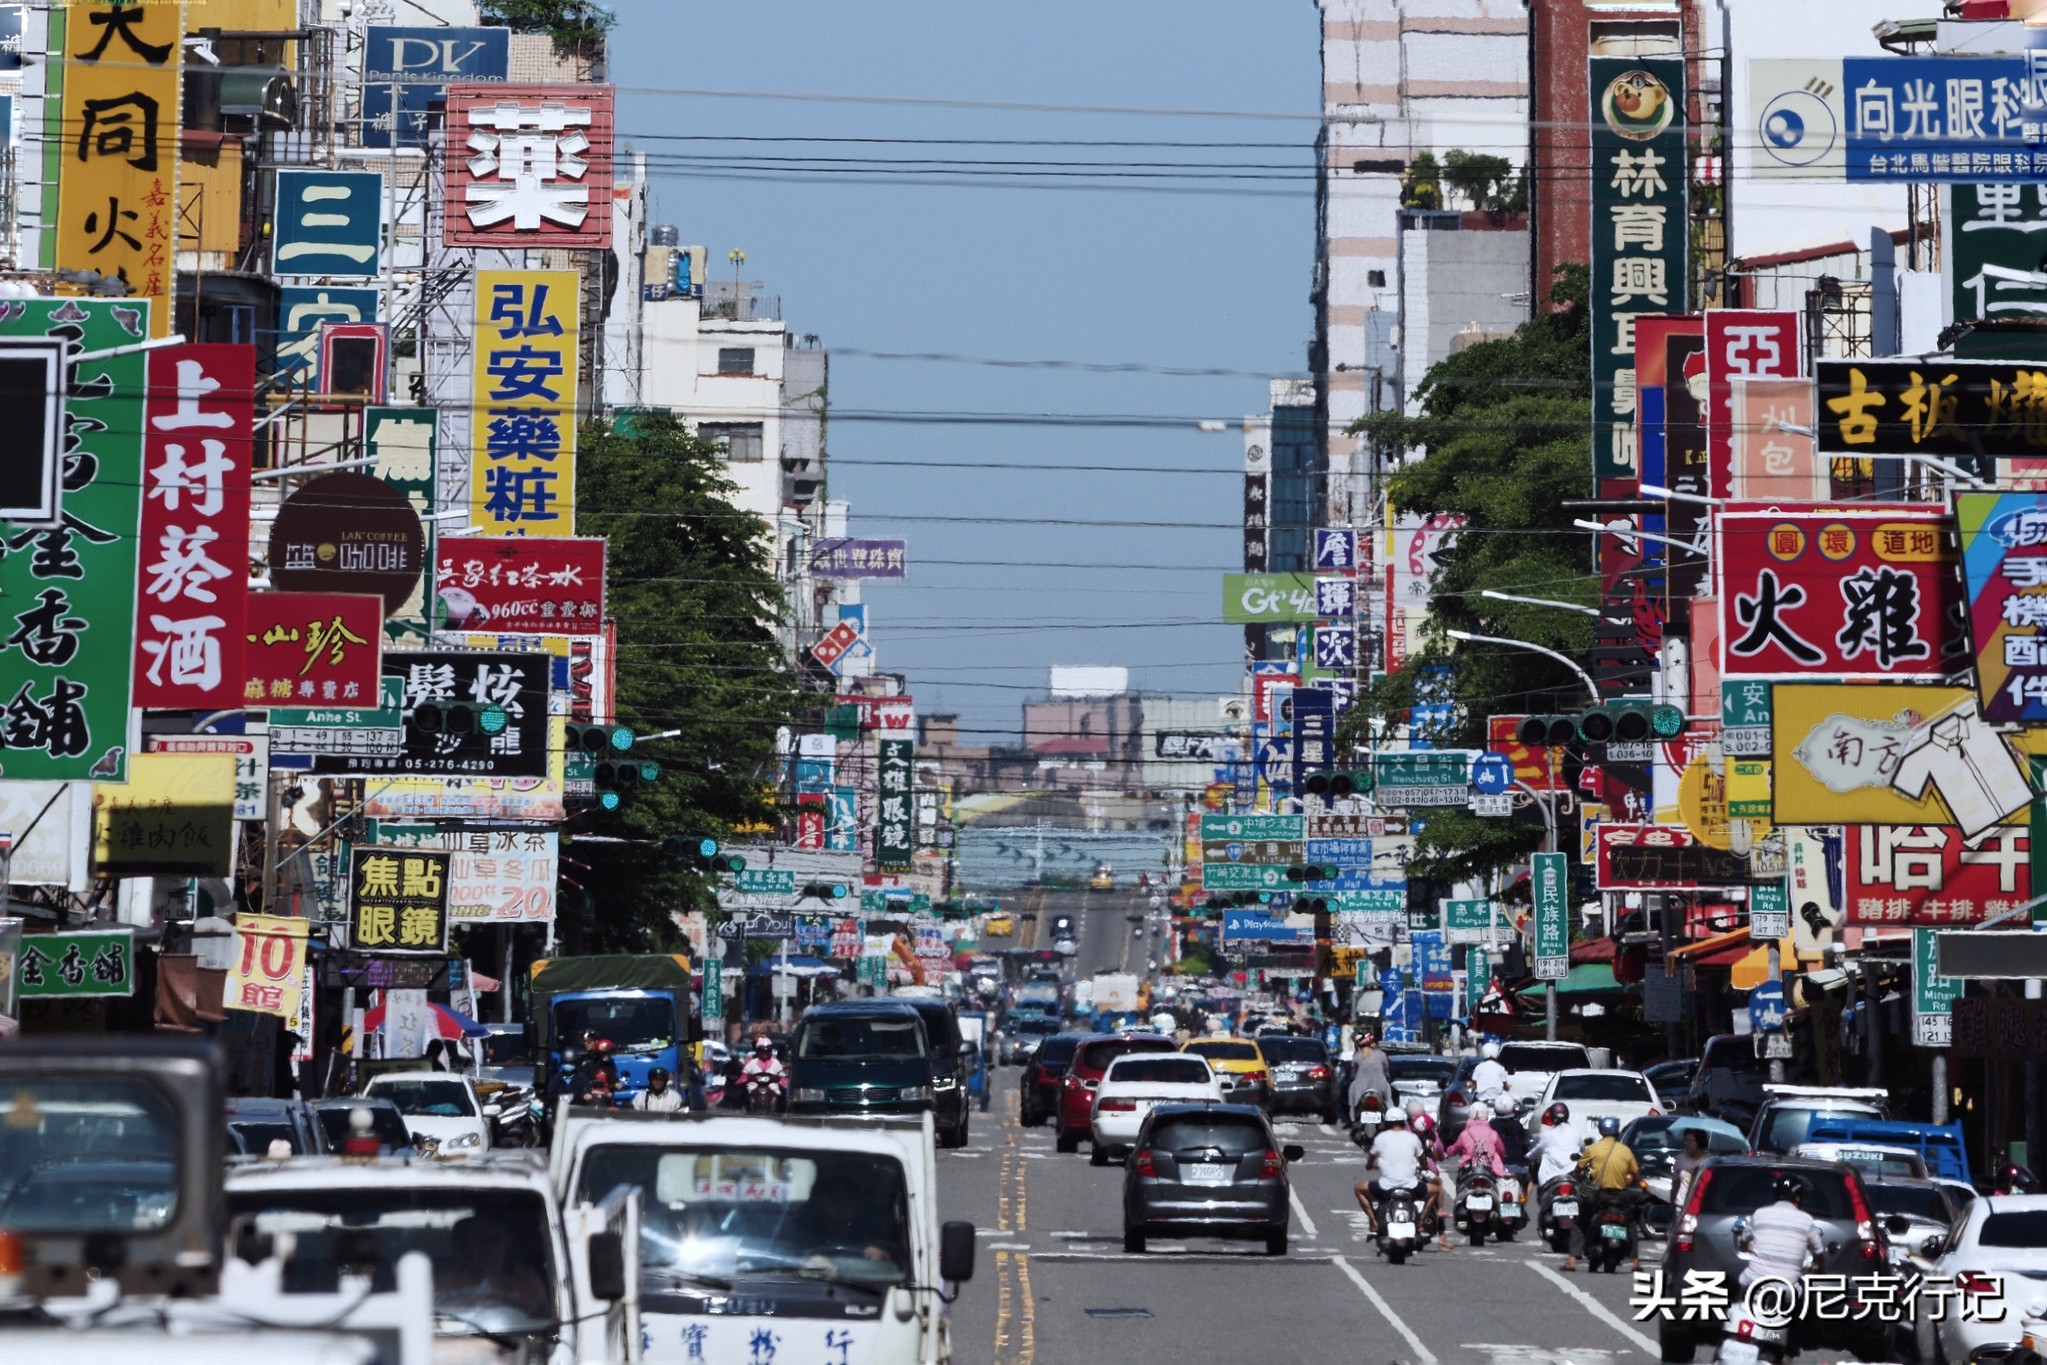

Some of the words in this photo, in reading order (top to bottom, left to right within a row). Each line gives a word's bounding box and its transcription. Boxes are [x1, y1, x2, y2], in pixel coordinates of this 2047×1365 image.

[369, 69, 417, 82] Pants
[422, 71, 503, 83] Kingdom
[146, 359, 236, 692] 上村菸酒
[1742, 682, 1765, 706] 安
[405, 759, 495, 771] 05-276-4290
[882, 742, 910, 850] 文雄眼鏡
[1243, 842, 1302, 856] 阿里山
[358, 855, 445, 899] 焦點
[1756, 893, 1782, 902] Minzu
[357, 904, 441, 946] 眼鏡
[1542, 886, 1560, 942] 民族路
[19, 942, 126, 987] 金香鋪
[239, 921, 296, 981] 10
